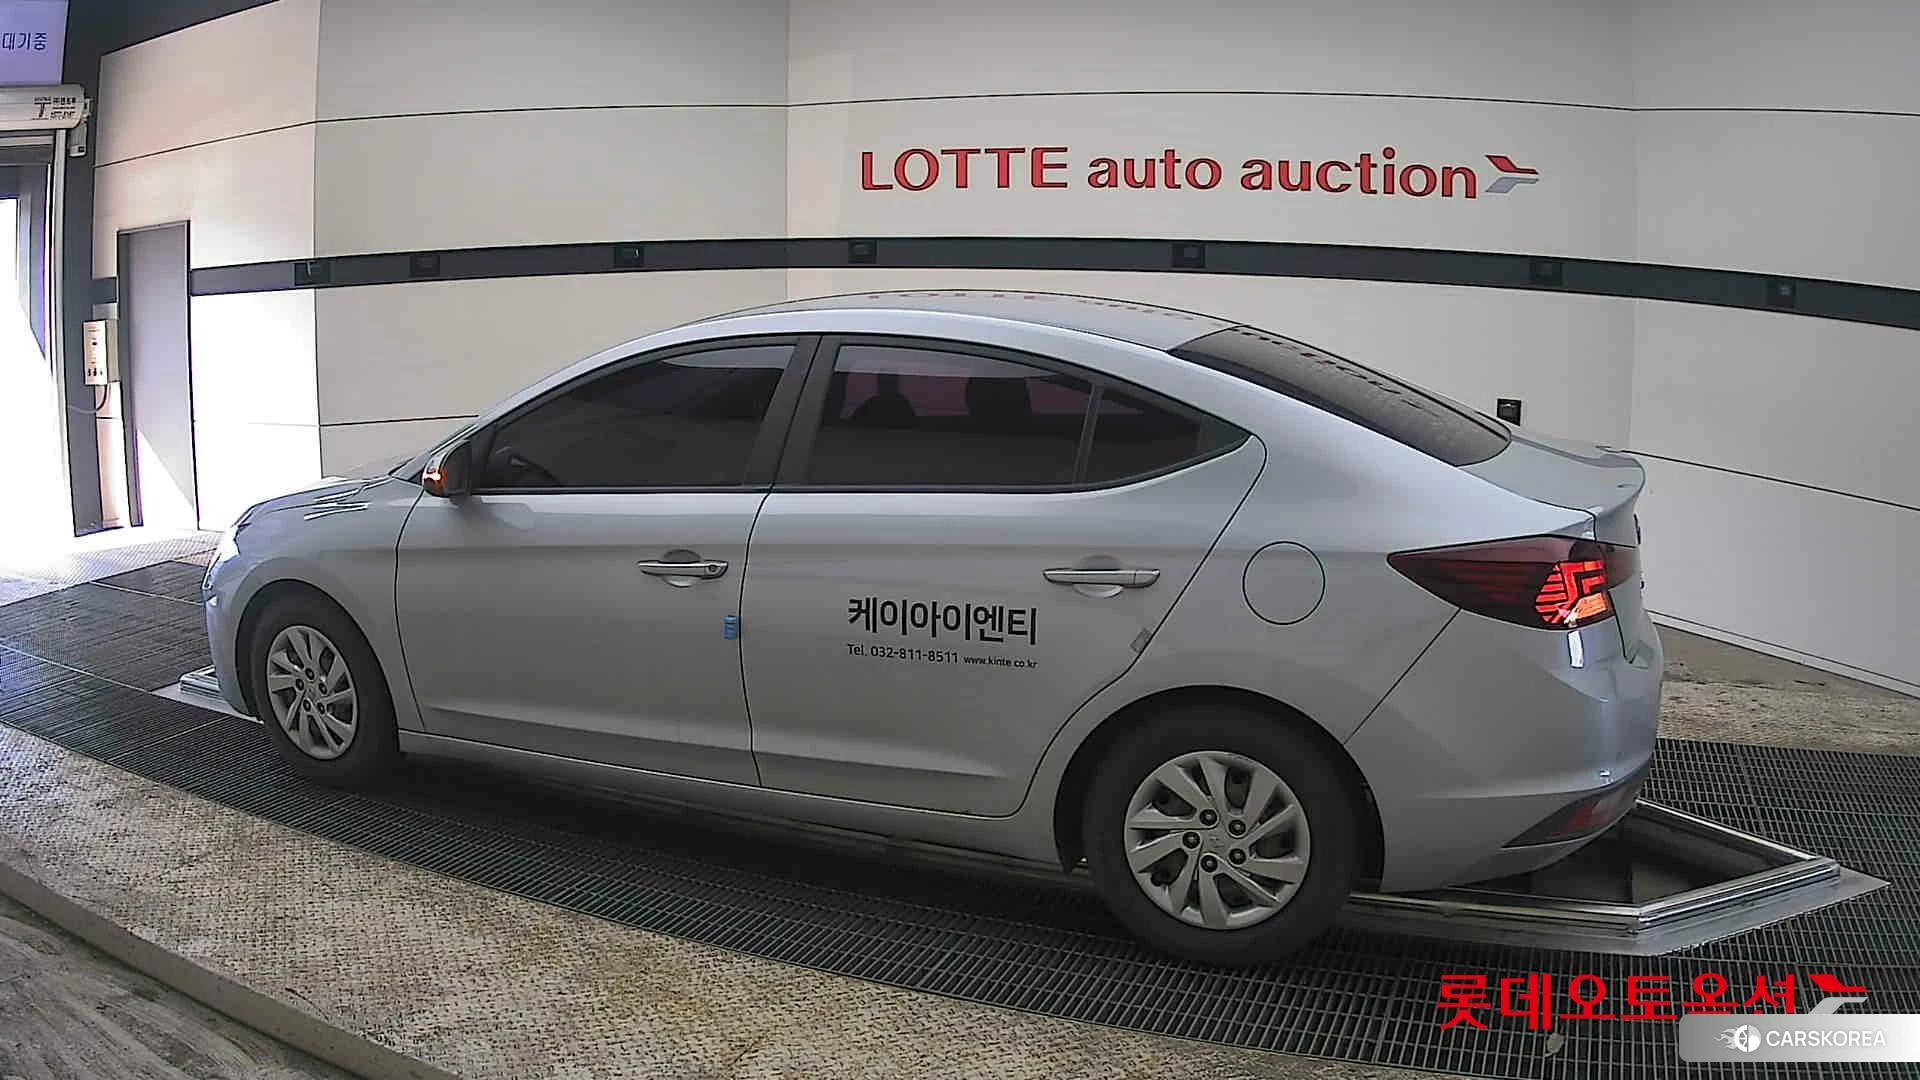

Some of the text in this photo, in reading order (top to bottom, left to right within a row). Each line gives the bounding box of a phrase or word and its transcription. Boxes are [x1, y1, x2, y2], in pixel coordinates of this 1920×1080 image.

[2, 32, 48, 51] 대기중
[861, 146, 1478, 199] LOTTE auto auction
[848, 597, 1037, 645] 케이아이엔티
[847, 643, 868, 657] Tel.
[870, 646, 958, 664] 032-811-8511
